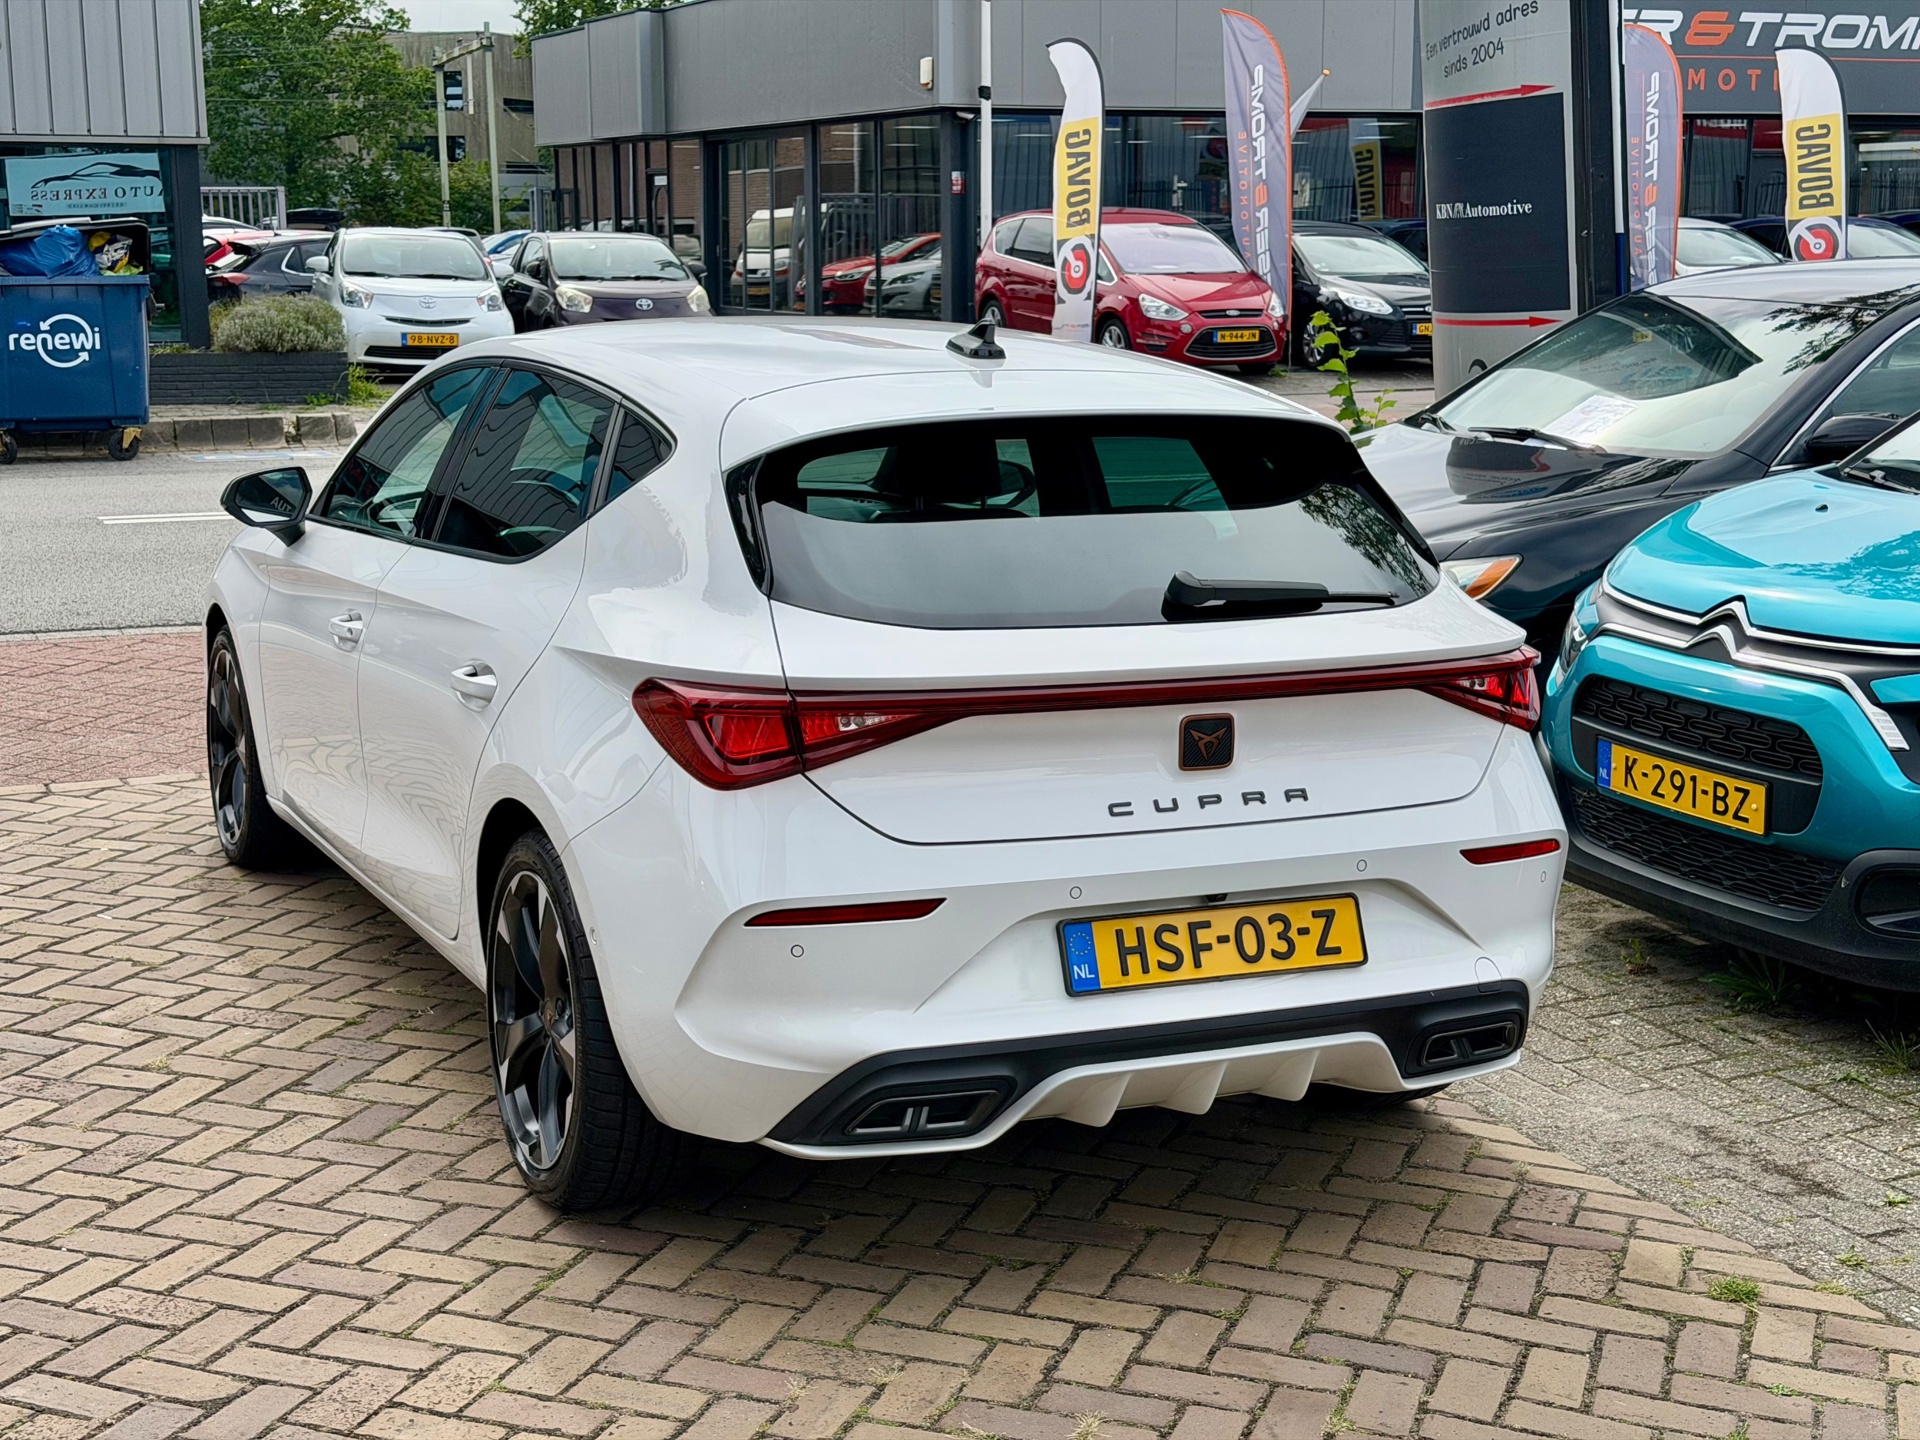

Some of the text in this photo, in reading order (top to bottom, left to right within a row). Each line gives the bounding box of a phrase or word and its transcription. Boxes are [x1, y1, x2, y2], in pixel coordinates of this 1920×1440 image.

[1425, 0, 1539, 60] Een vertrouwd adres
[1738, 12, 1920, 50] TROM
[1443, 37, 1504, 78] sinds 2004
[1465, 199, 1533, 218] Automotive
[8, 326, 101, 351] renewi
[410, 335, 455, 344] 98-NVZ-8
[1219, 332, 1257, 341] N-944-JN
[1599, 767, 1609, 780] NL
[1107, 787, 1309, 817] CUPRA
[1624, 754, 1750, 824] K-291-BZ
[1115, 908, 1342, 976] HSF-03-Z
[1073, 964, 1095, 980] NL
